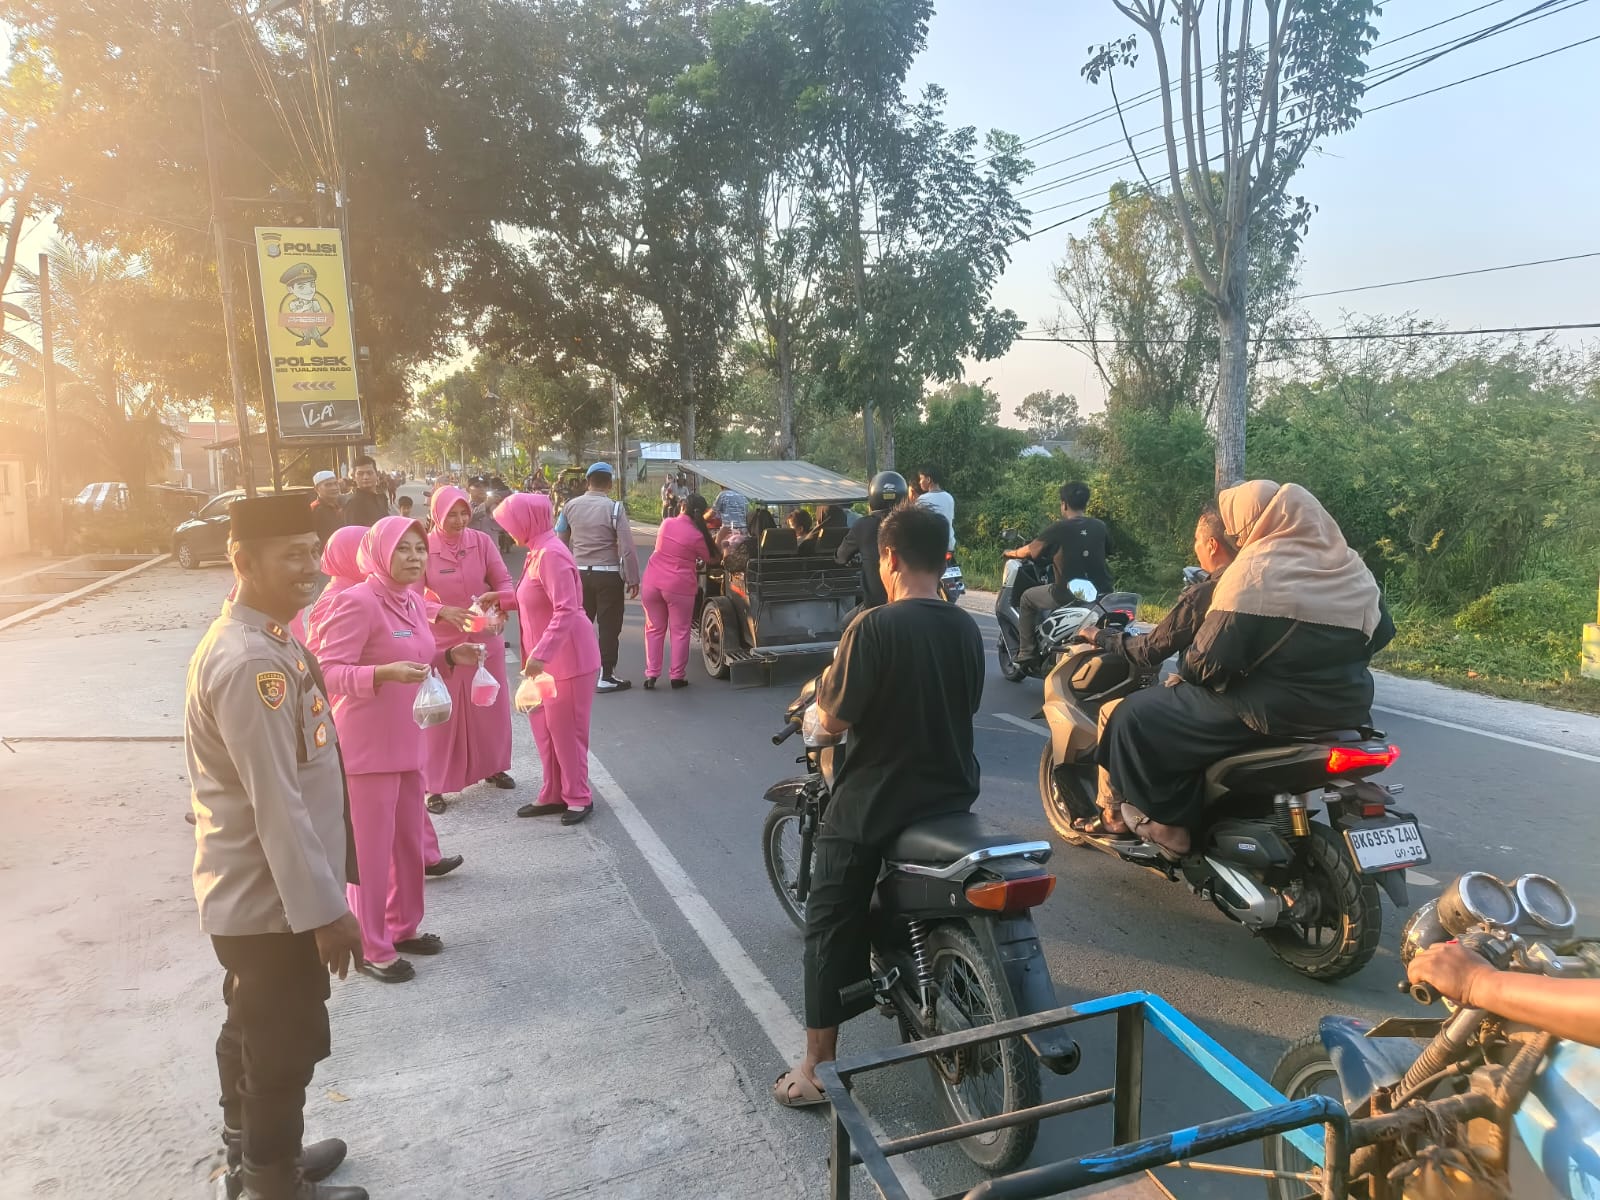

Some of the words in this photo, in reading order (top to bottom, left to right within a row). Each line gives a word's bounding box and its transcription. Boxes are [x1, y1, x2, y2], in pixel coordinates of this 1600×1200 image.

[284, 243, 337, 253] POLISI
[275, 356, 348, 367] POLSEK
[1395, 826, 1418, 843] ZAU
